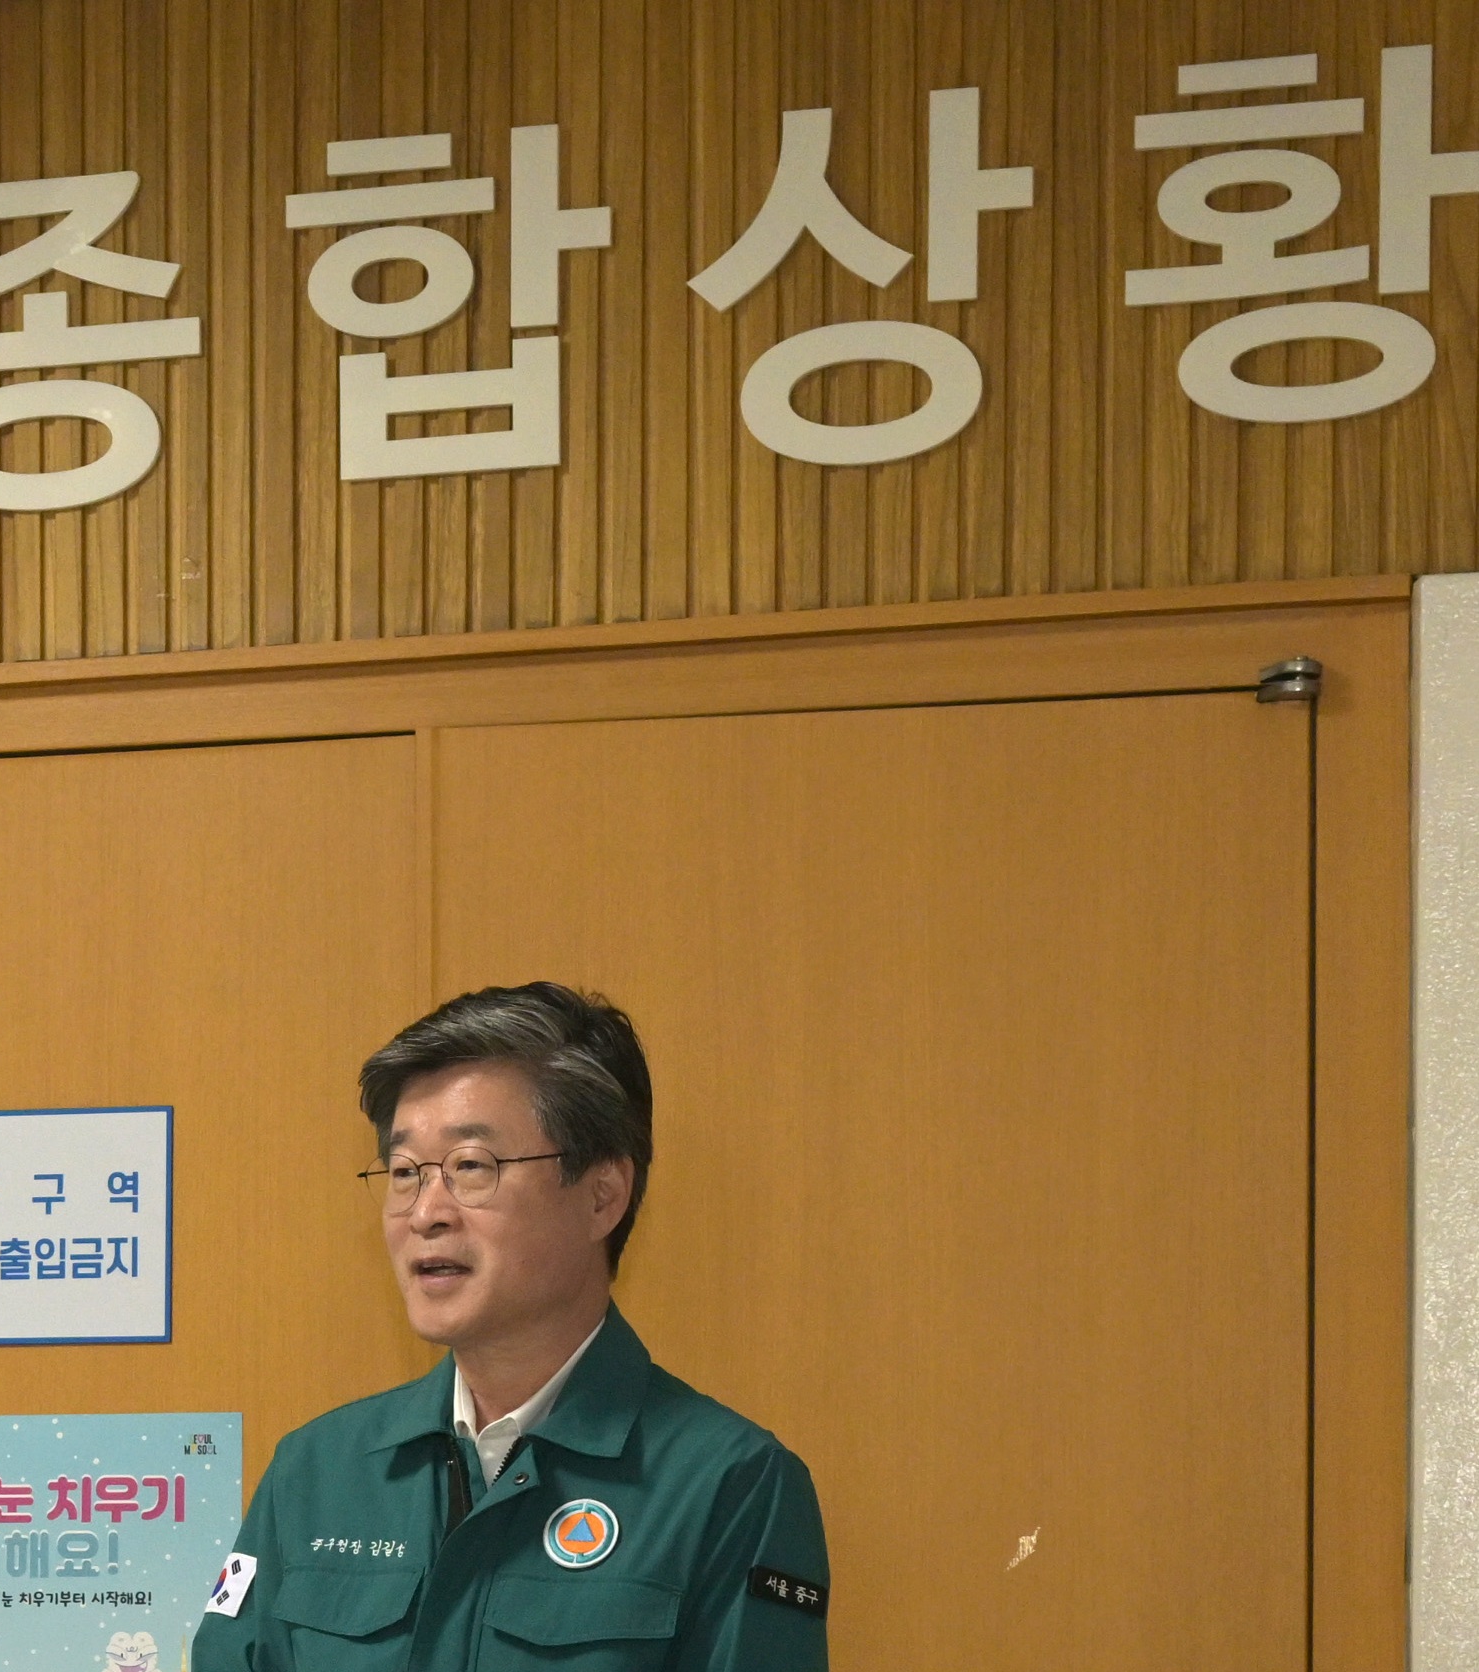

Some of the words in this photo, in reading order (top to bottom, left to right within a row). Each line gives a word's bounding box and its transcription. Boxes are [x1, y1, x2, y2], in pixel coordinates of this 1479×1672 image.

[46, 1473, 186, 1523] 치우기
[1, 1592, 14, 1607] 눈
[18, 1591, 87, 1607] 치우기부터
[91, 1591, 153, 1607] 시작해요!
[766, 1576, 789, 1598] 서울
[795, 1586, 818, 1605] 중구
